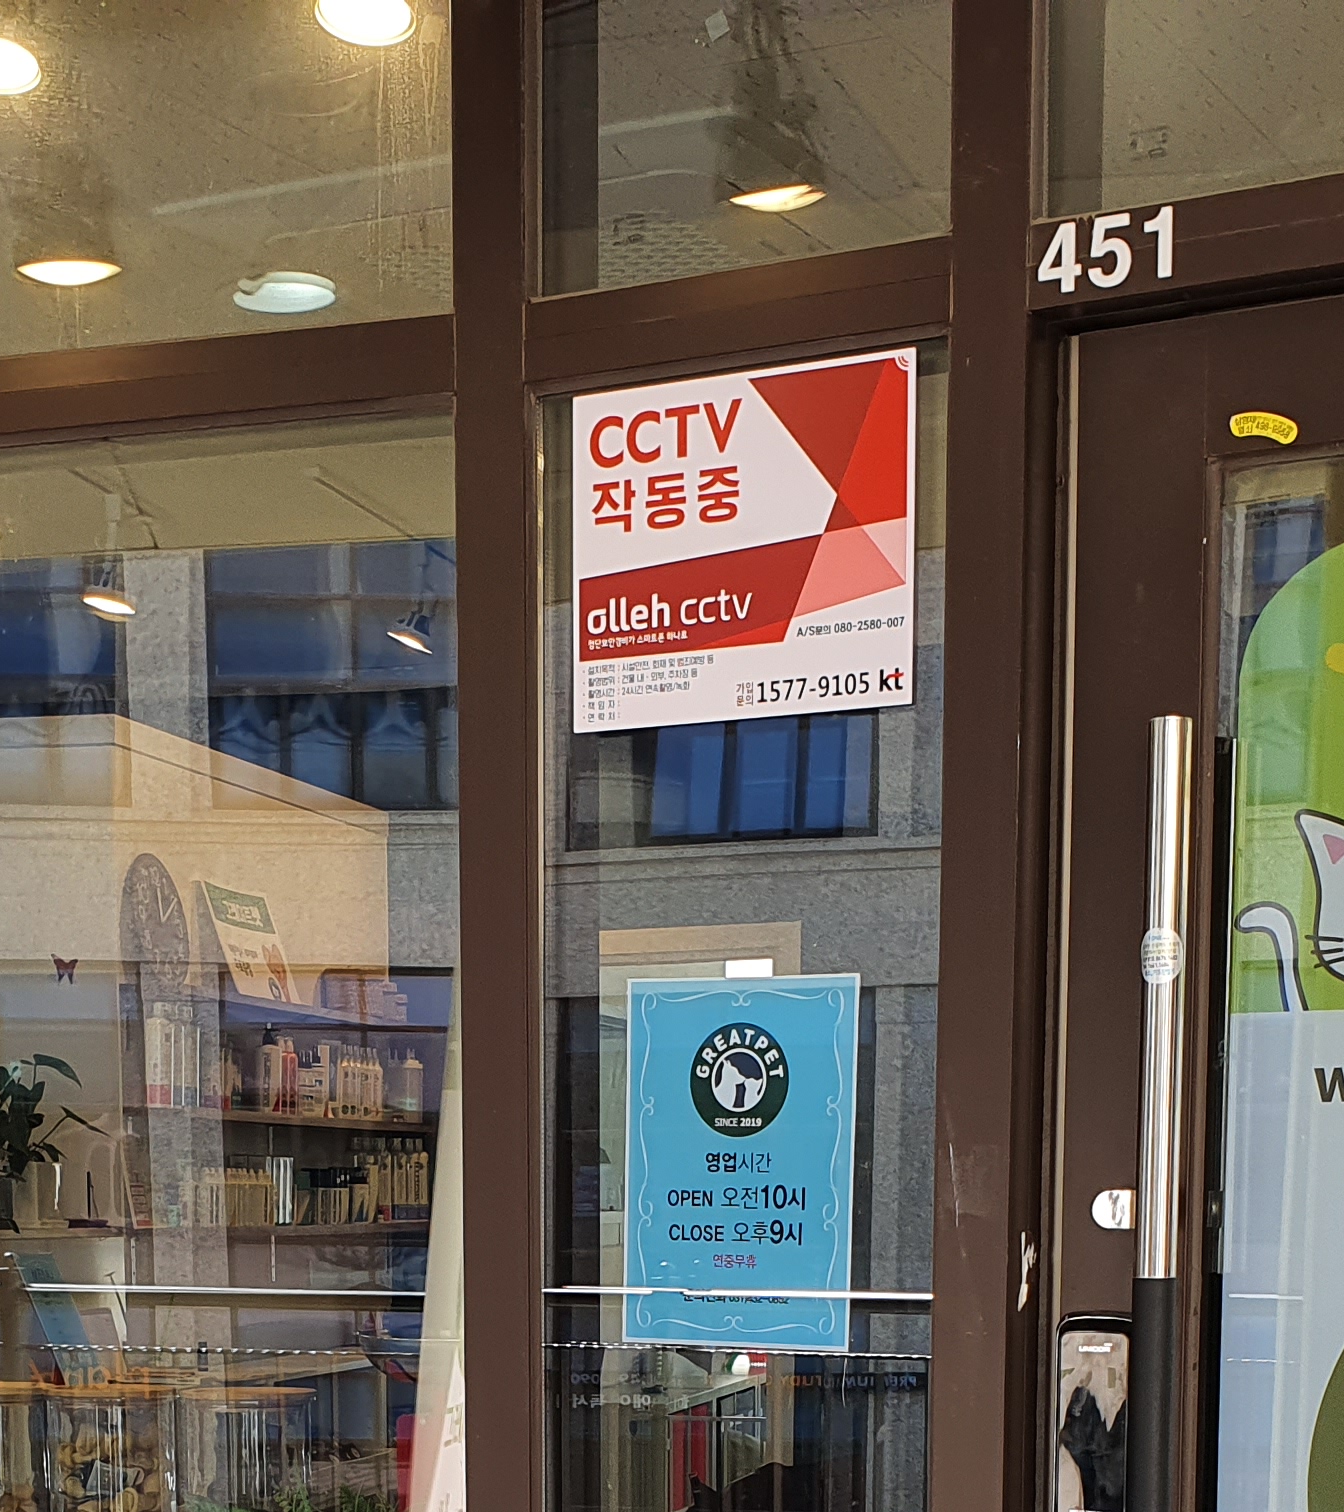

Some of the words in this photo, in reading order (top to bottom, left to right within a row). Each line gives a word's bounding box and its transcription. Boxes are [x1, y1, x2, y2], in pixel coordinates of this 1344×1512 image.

[1037, 205, 1174, 293] 451
[589, 398, 743, 469] CCTV
[591, 466, 740, 532] 작동중
[587, 593, 670, 635] olleh
[679, 589, 753, 626] cctv
[796, 625, 831, 637] A/S문의
[834, 616, 905, 633] 080-2580-007
[757, 672, 870, 703] 1577-9105
[879, 667, 904, 692] kt
[695, 1027, 784, 1079] GREATPET
[714, 1117, 739, 1128] SINCE
[739, 1117, 762, 1128] 2019
[705, 1152, 772, 1174] 영업시간
[667, 1190, 713, 1207] OPEN
[720, 1185, 806, 1212] 오전10시
[669, 1224, 724, 1243] CLOSE
[731, 1219, 803, 1245] 오후9시
